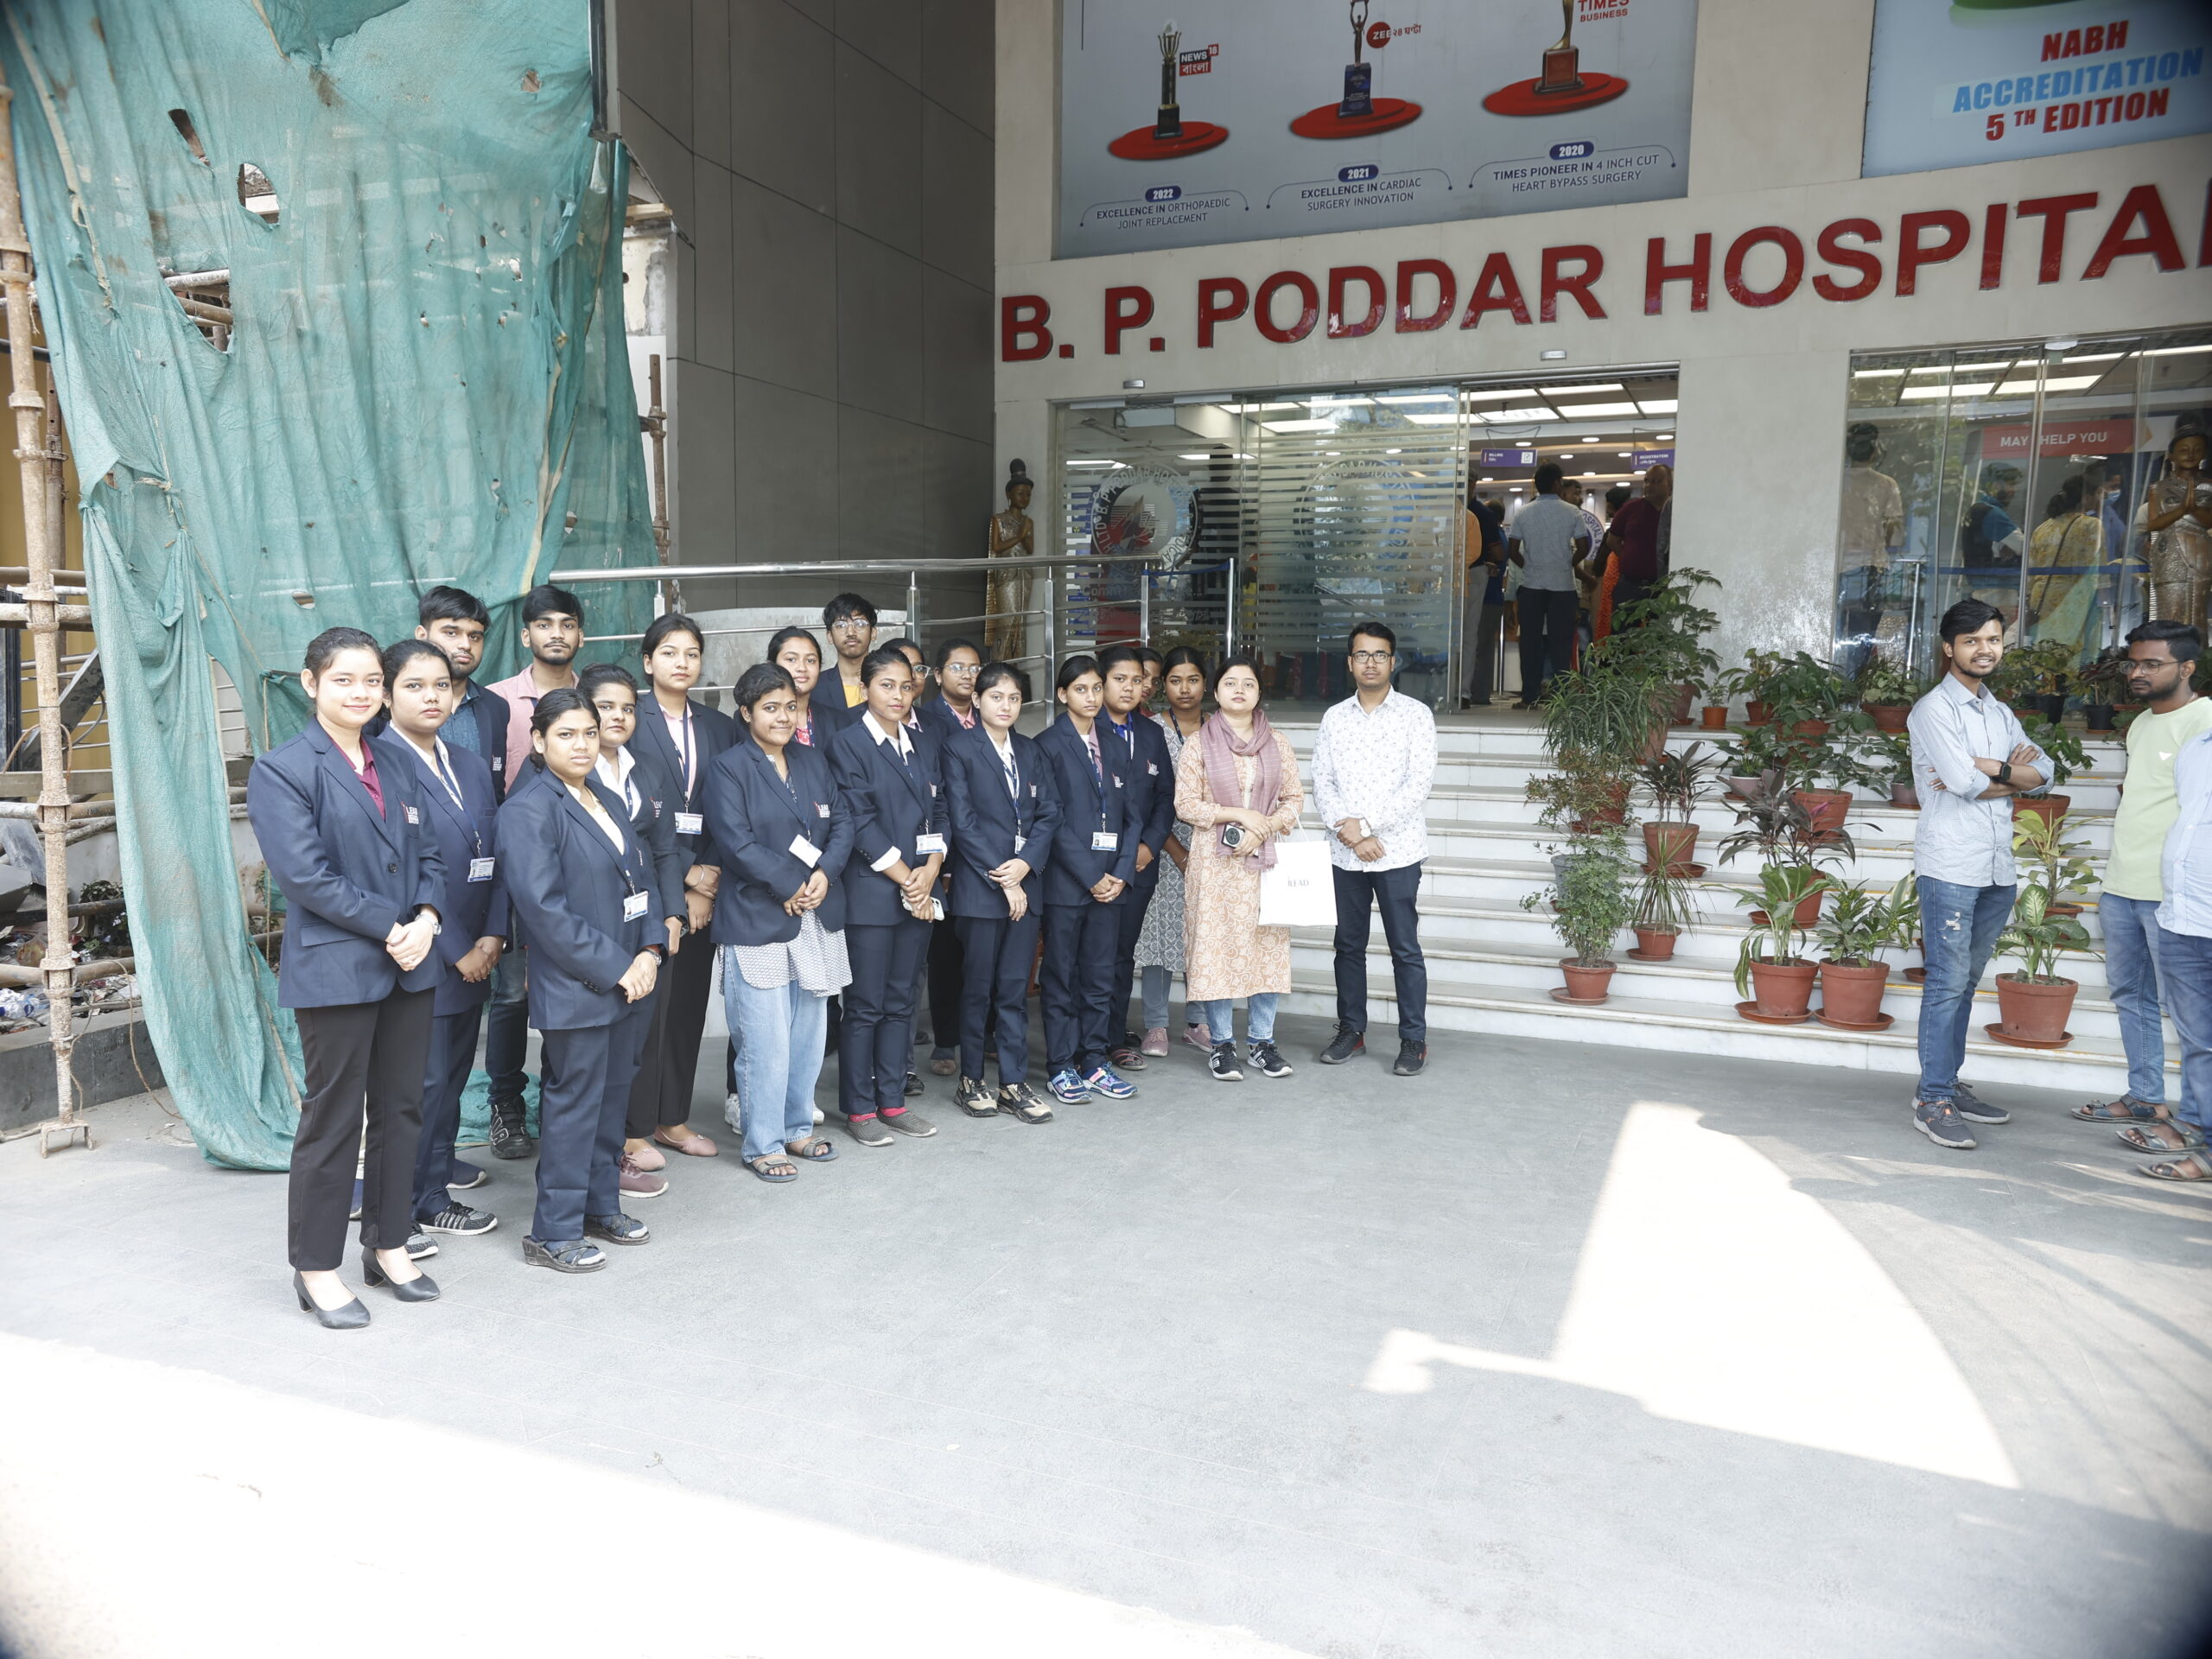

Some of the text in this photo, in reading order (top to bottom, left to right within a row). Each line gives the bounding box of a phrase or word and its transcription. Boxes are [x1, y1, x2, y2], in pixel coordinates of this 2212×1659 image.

[1580, 8, 1629, 22] BUSINESS
[1372, 29, 1391, 41] ZEE
[2040, 19, 2130, 63] NABH
[1180, 46, 1217, 63] NEWS 18
[1952, 47, 2203, 113] ACCREDITATION
[2042, 87, 2171, 133] EDITION
[1559, 144, 1585, 157] 2020
[1347, 167, 1370, 180] 2021
[1493, 154, 1660, 181] TIMES PIONEER IN 4 INCH CUT
[1301, 177, 1422, 199] EXCELLENCE IN CARDIAC
[1512, 170, 1642, 193] HEART BYPASS SURGERY
[1153, 188, 1173, 200] 2022
[1307, 192, 1414, 212] SURGERY INNOVATION
[1096, 198, 1230, 219] EXCELLENCE IN ORTHOPAEDIC
[1117, 213, 1208, 230] JOINT REPLACEMENT
[1001, 177, 2212, 362] B. P. PODDAR HOSPITA
[2000, 431, 2108, 447] MAY HELP YOU
